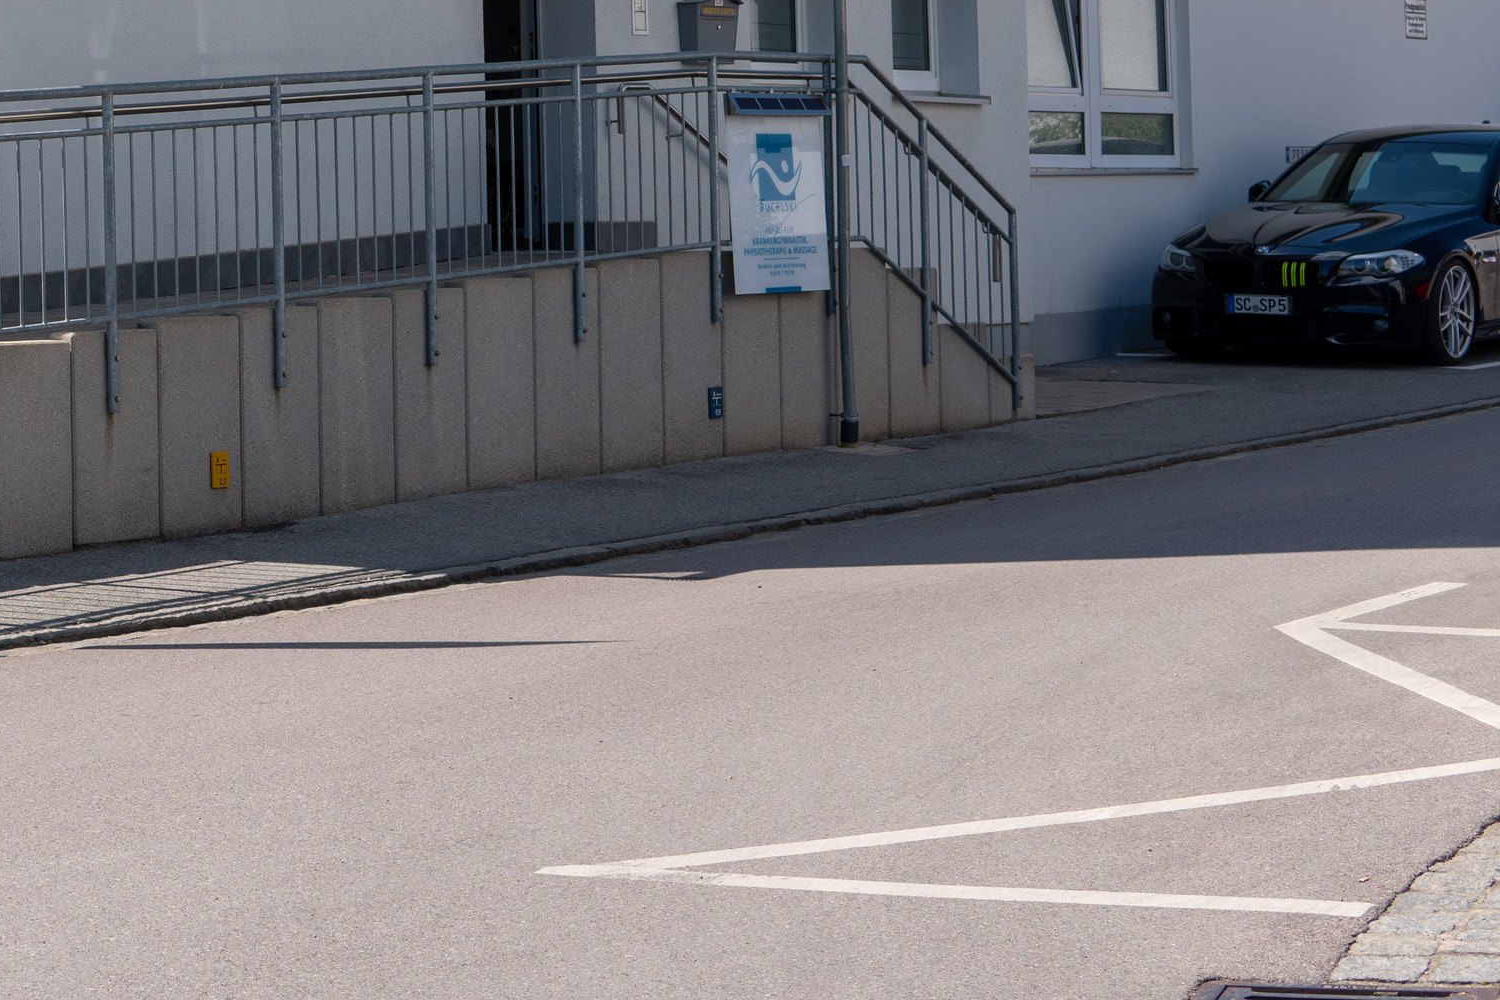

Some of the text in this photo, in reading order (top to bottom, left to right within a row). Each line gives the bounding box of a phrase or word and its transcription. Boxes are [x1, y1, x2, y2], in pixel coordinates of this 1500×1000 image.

[760, 201, 797, 212] BUCELSKI
[793, 245, 818, 254] MASSAGE
[1235, 297, 1252, 311] SC
